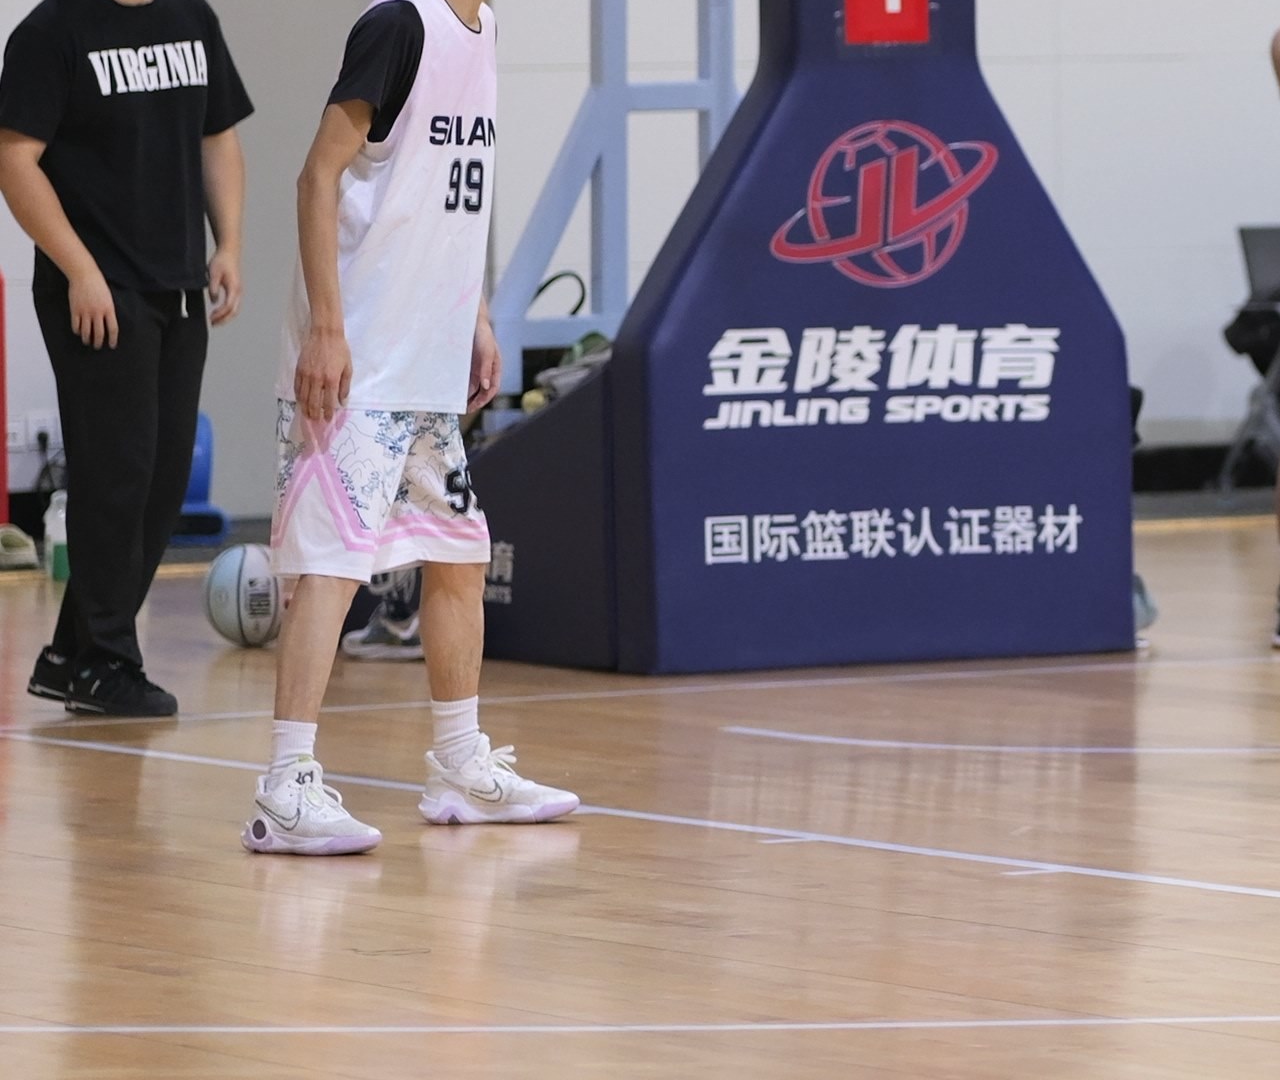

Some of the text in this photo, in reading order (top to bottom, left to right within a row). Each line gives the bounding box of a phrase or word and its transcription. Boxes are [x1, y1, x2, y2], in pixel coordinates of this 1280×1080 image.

[87, 39, 208, 96] VIRGINIA
[444, 157, 484, 215] 99
[702, 323, 1061, 396] 金陵体育
[702, 393, 1052, 430] JINLING SPORTS
[704, 503, 1084, 565] 国际篮联认证器材
